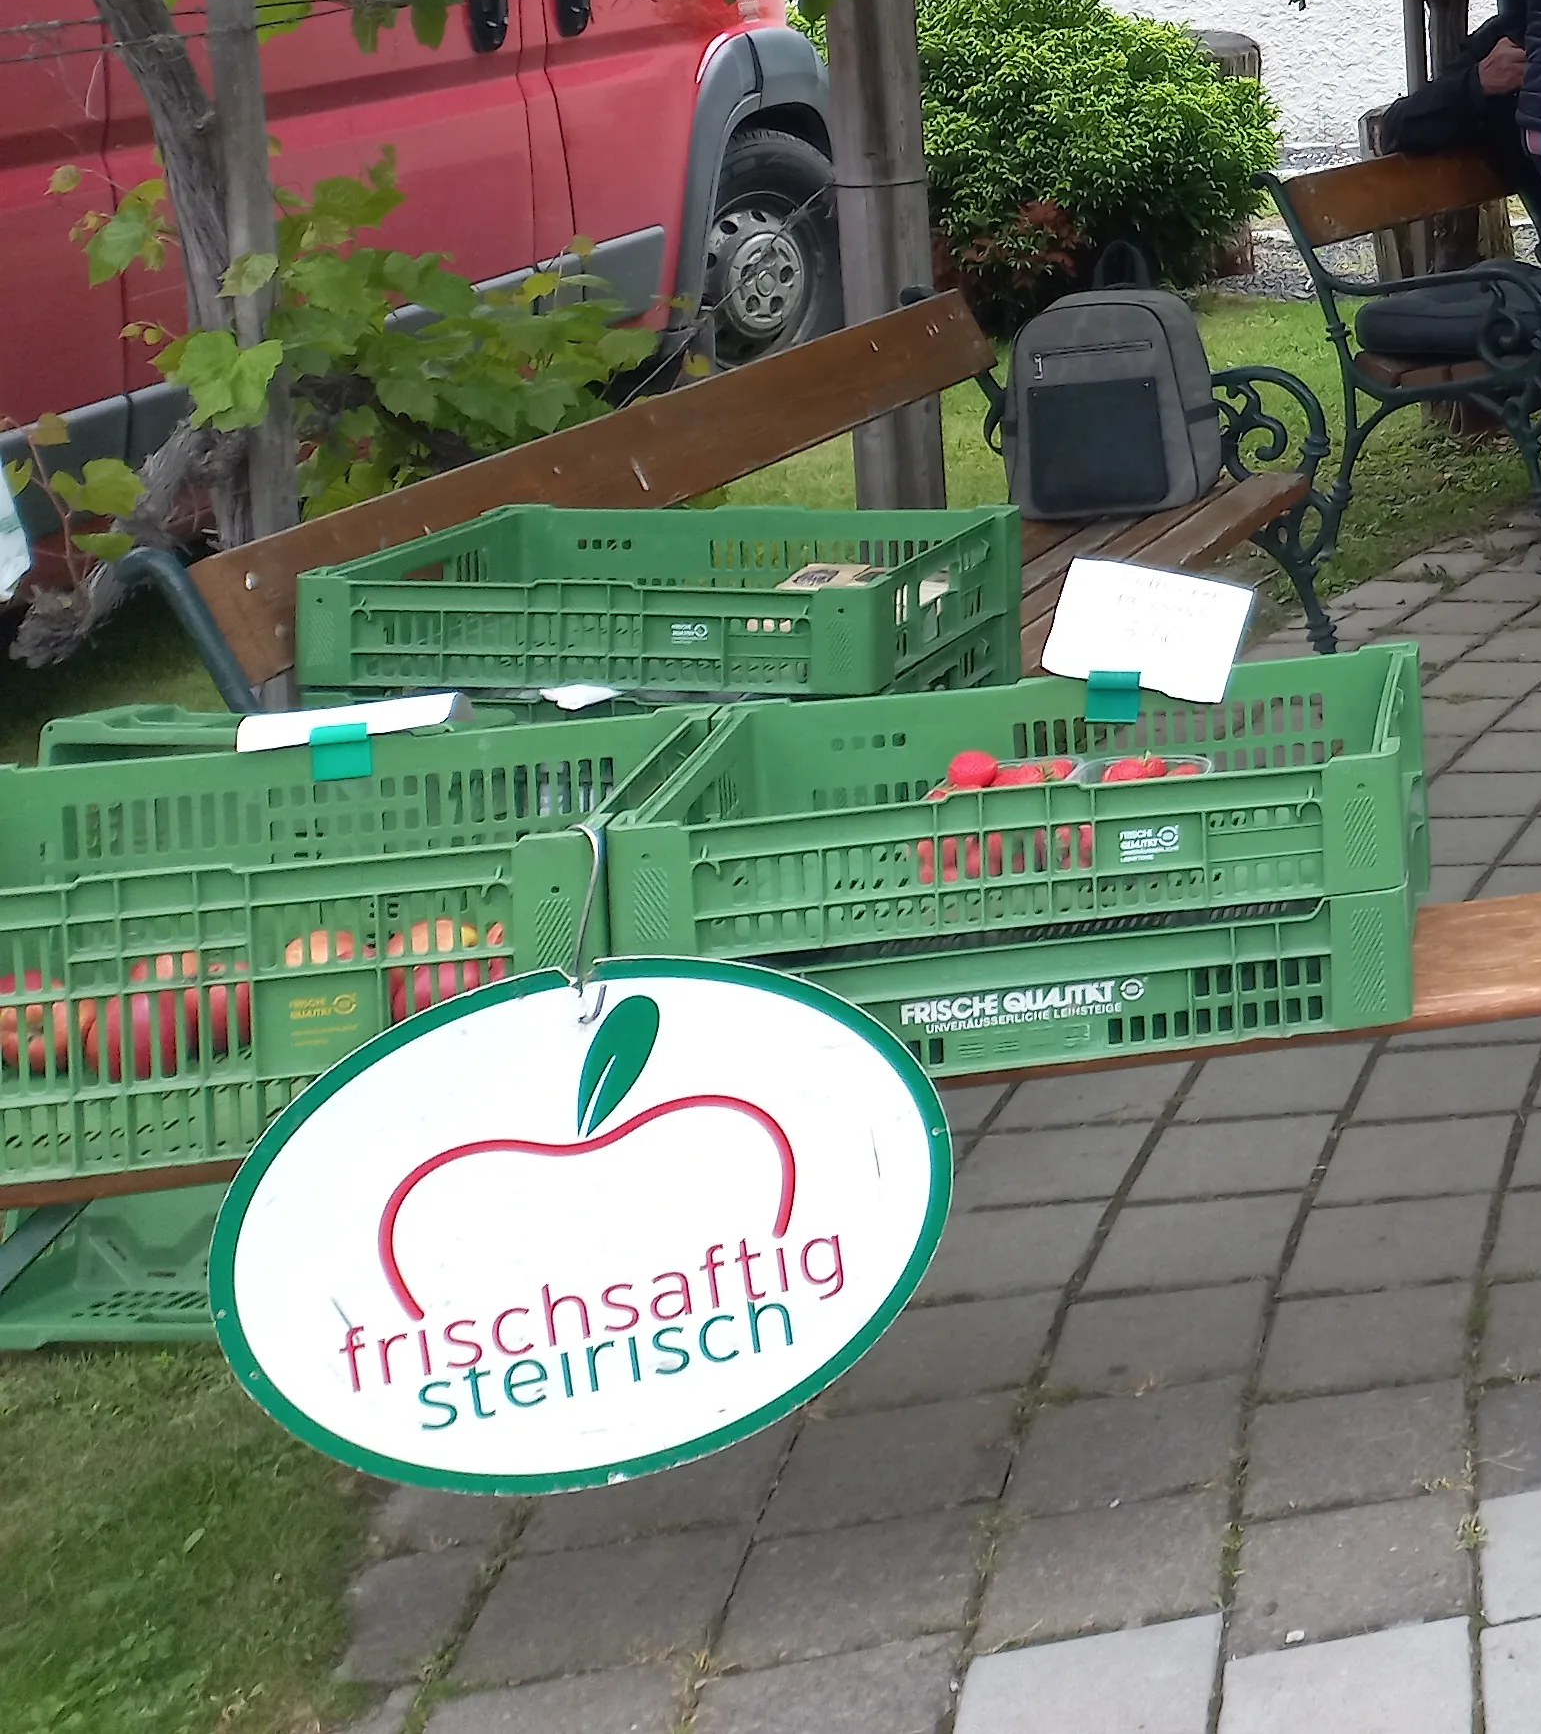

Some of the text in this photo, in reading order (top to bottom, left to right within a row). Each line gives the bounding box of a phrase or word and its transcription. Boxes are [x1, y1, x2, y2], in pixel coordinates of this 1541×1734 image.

[901, 993, 999, 1026] FRISCHE
[338, 1232, 846, 1393] frischsaftig
[417, 1300, 795, 1432] steirisch
